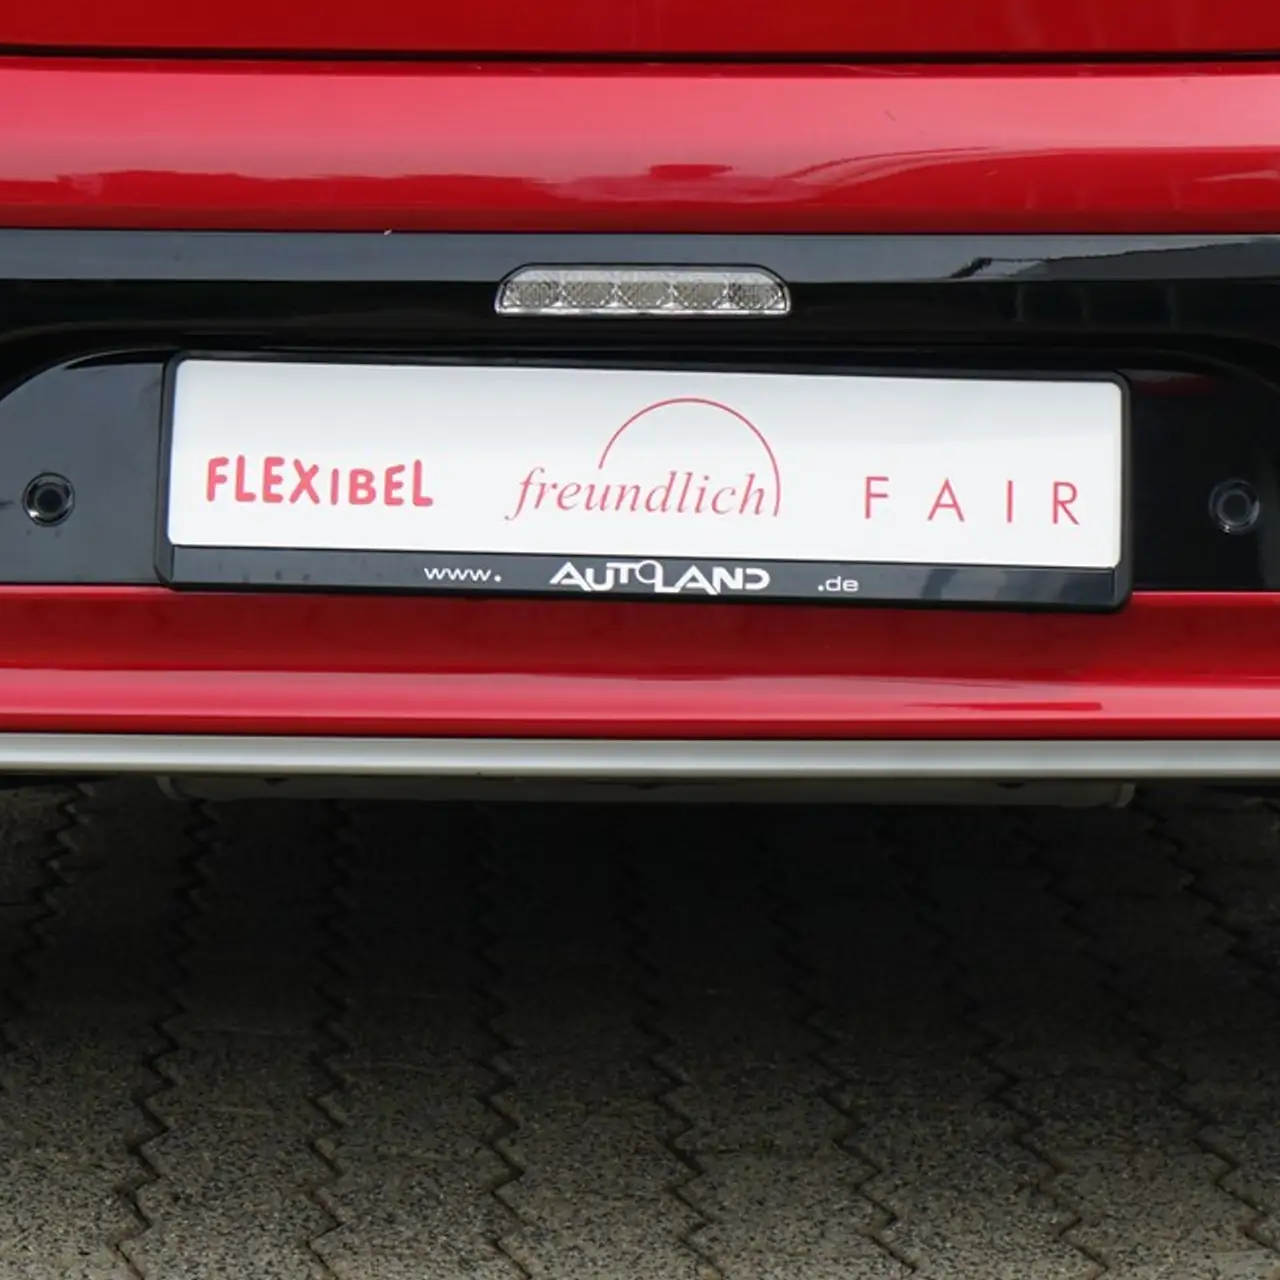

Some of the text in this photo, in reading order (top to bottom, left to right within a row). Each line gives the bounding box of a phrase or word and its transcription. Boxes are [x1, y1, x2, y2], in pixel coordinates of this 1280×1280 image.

[205, 456, 1081, 526] FLEXIBEL freundlich FAIR
[549, 559, 772, 595] AUTOLAND
